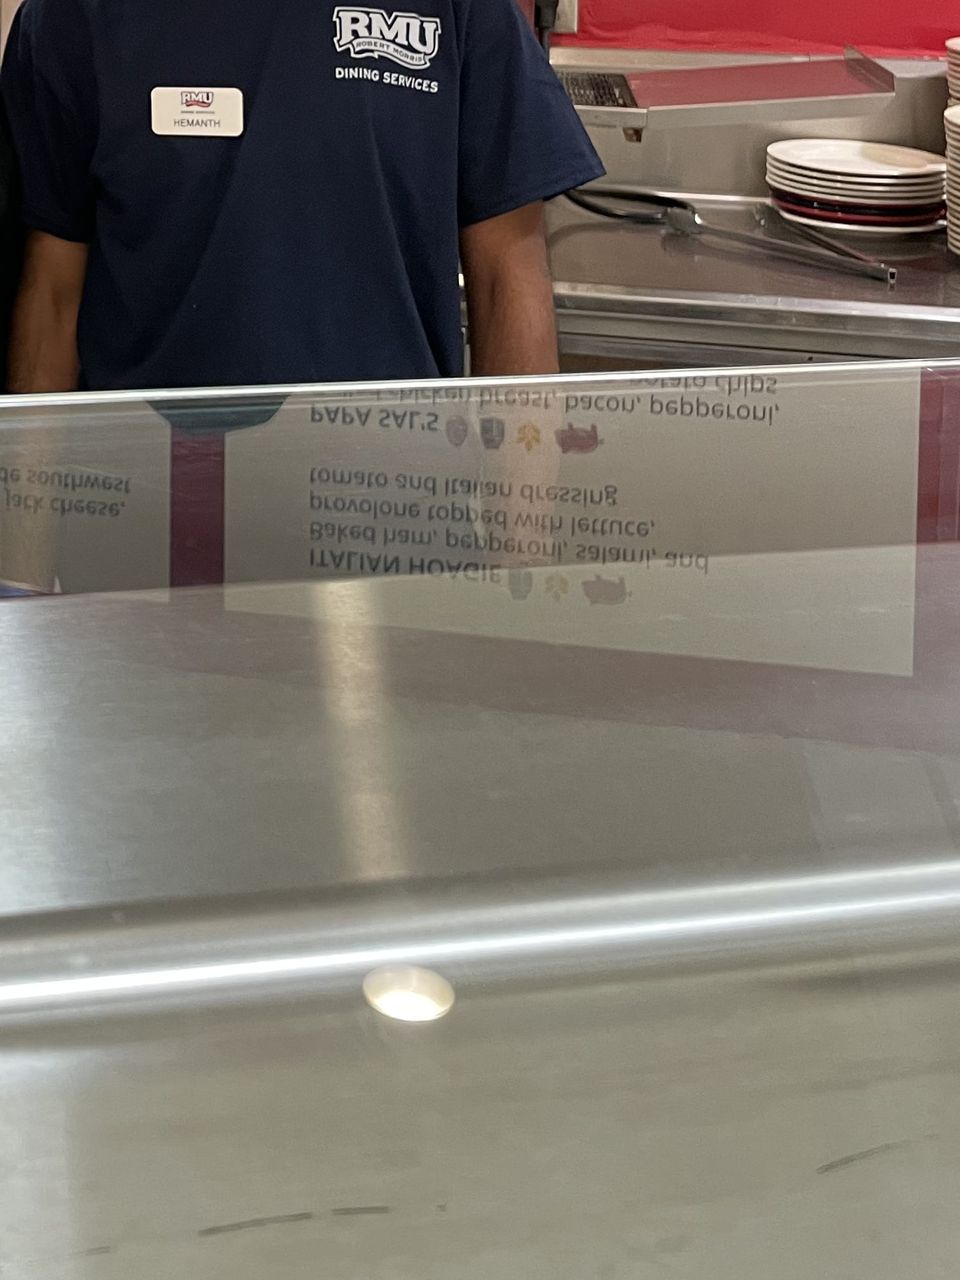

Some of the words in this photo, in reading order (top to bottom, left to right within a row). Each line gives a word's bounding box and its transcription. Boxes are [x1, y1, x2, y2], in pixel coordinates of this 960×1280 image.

[336, 9, 439, 55] RMU
[335, 67, 380, 82] DINING
[382, 71, 439, 93] SERVICES
[173, 118, 221, 128] HEMANTH
